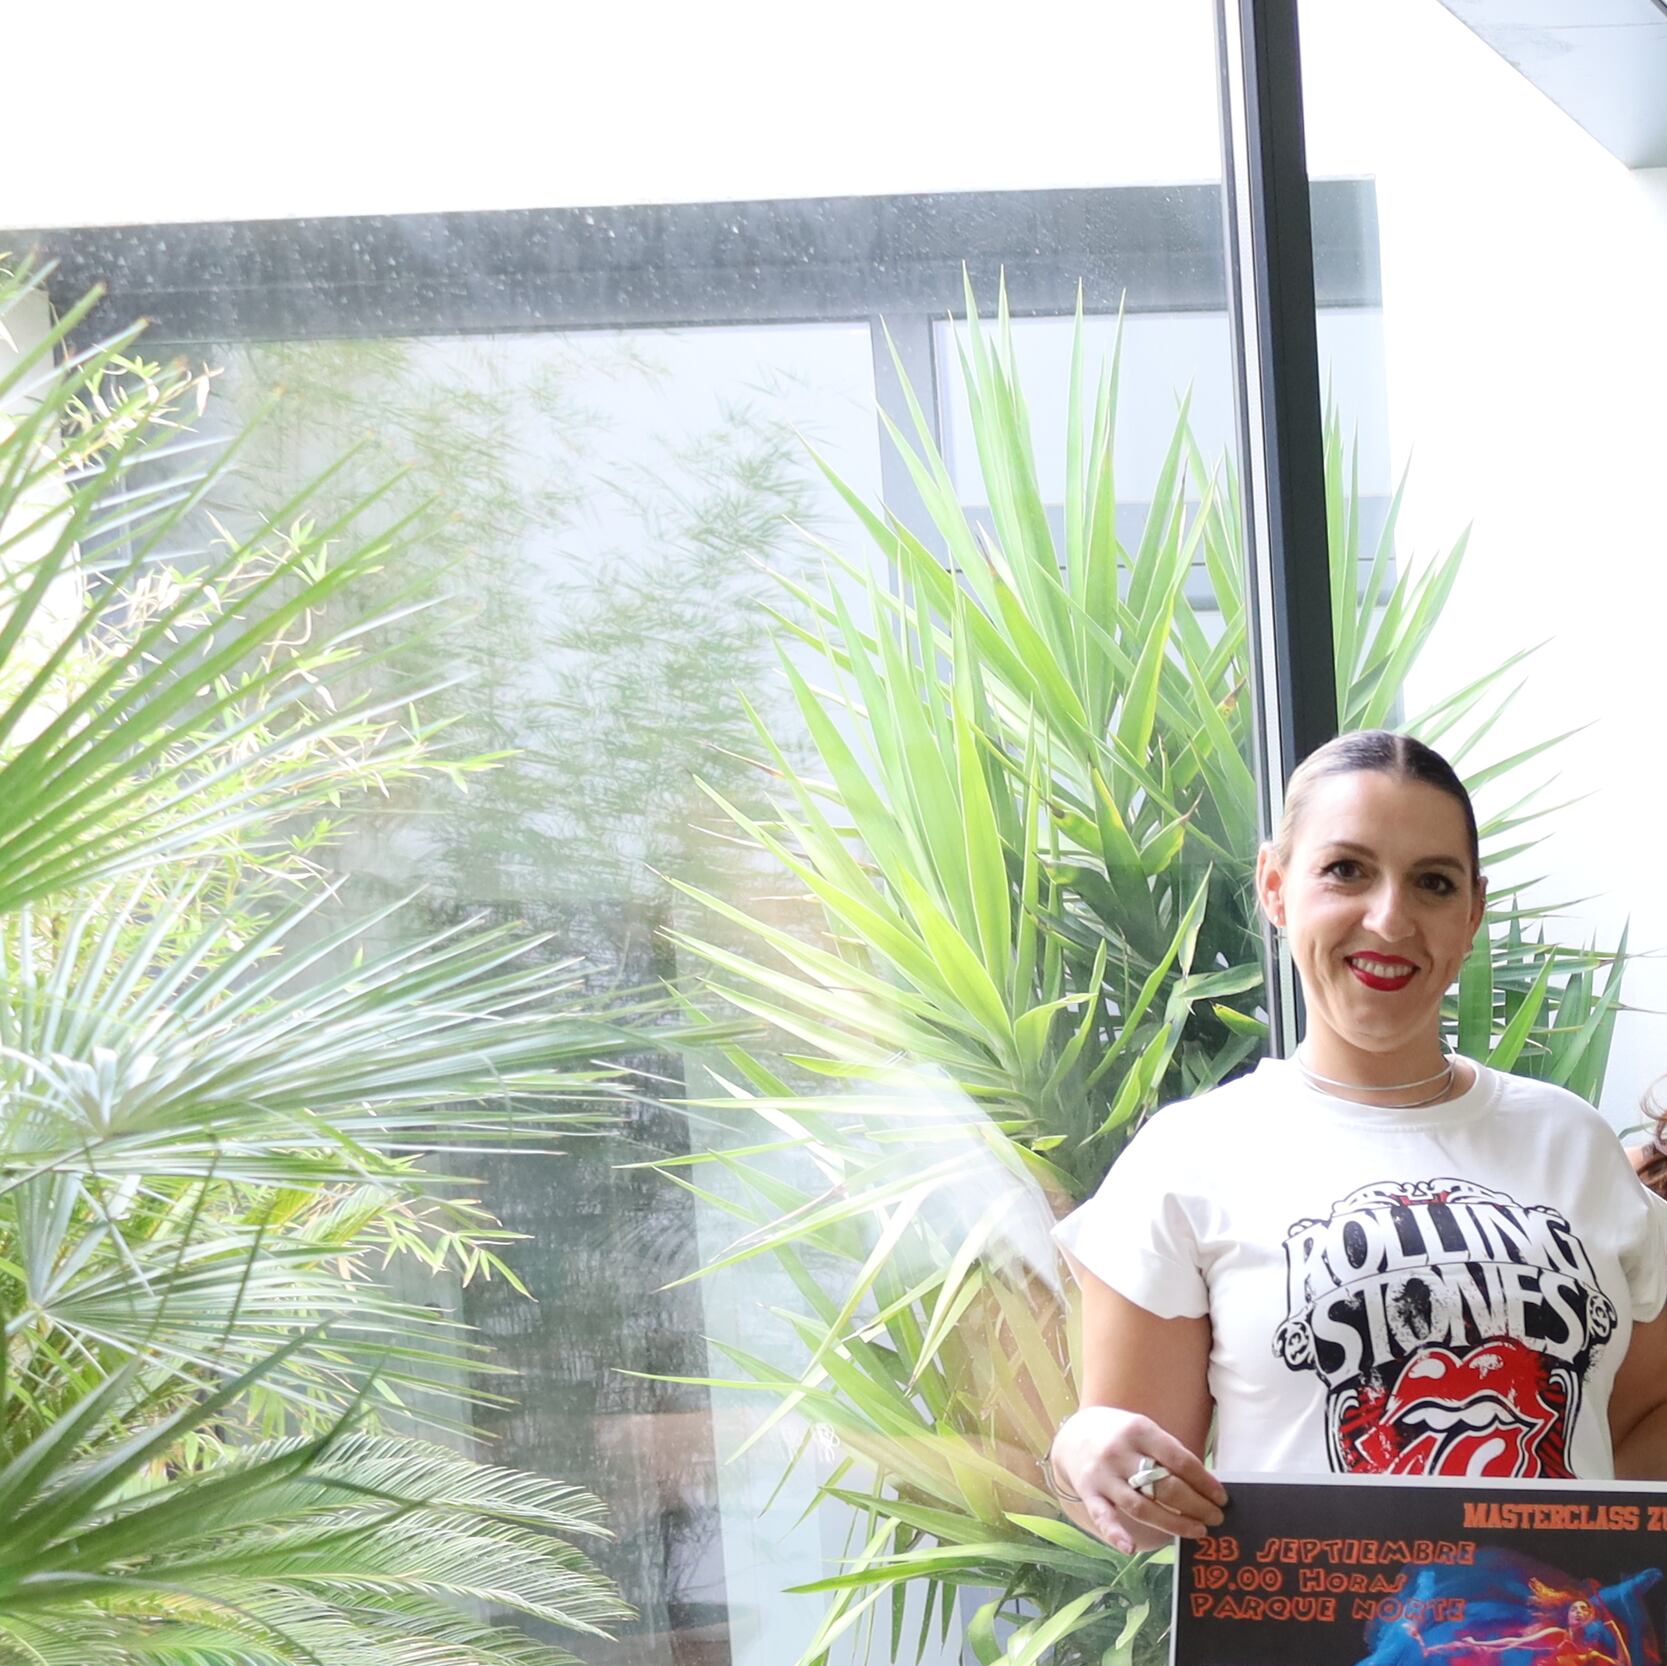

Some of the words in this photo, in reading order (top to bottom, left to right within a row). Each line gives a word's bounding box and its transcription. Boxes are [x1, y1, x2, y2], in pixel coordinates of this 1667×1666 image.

[1282, 1198, 1598, 1320] ROLLING
[1309, 1261, 1595, 1391] STONES
[1464, 1502, 1640, 1531] MASTERCLASS
[1193, 1535, 1240, 1562] 23
[1256, 1537, 1476, 1566] SEPTIEMBRE
[1191, 1564, 1283, 1592] 19.00
[1299, 1567, 1408, 1593] HORAS
[1189, 1593, 1336, 1622] PARQUE
[1352, 1597, 1468, 1622] NORTE
